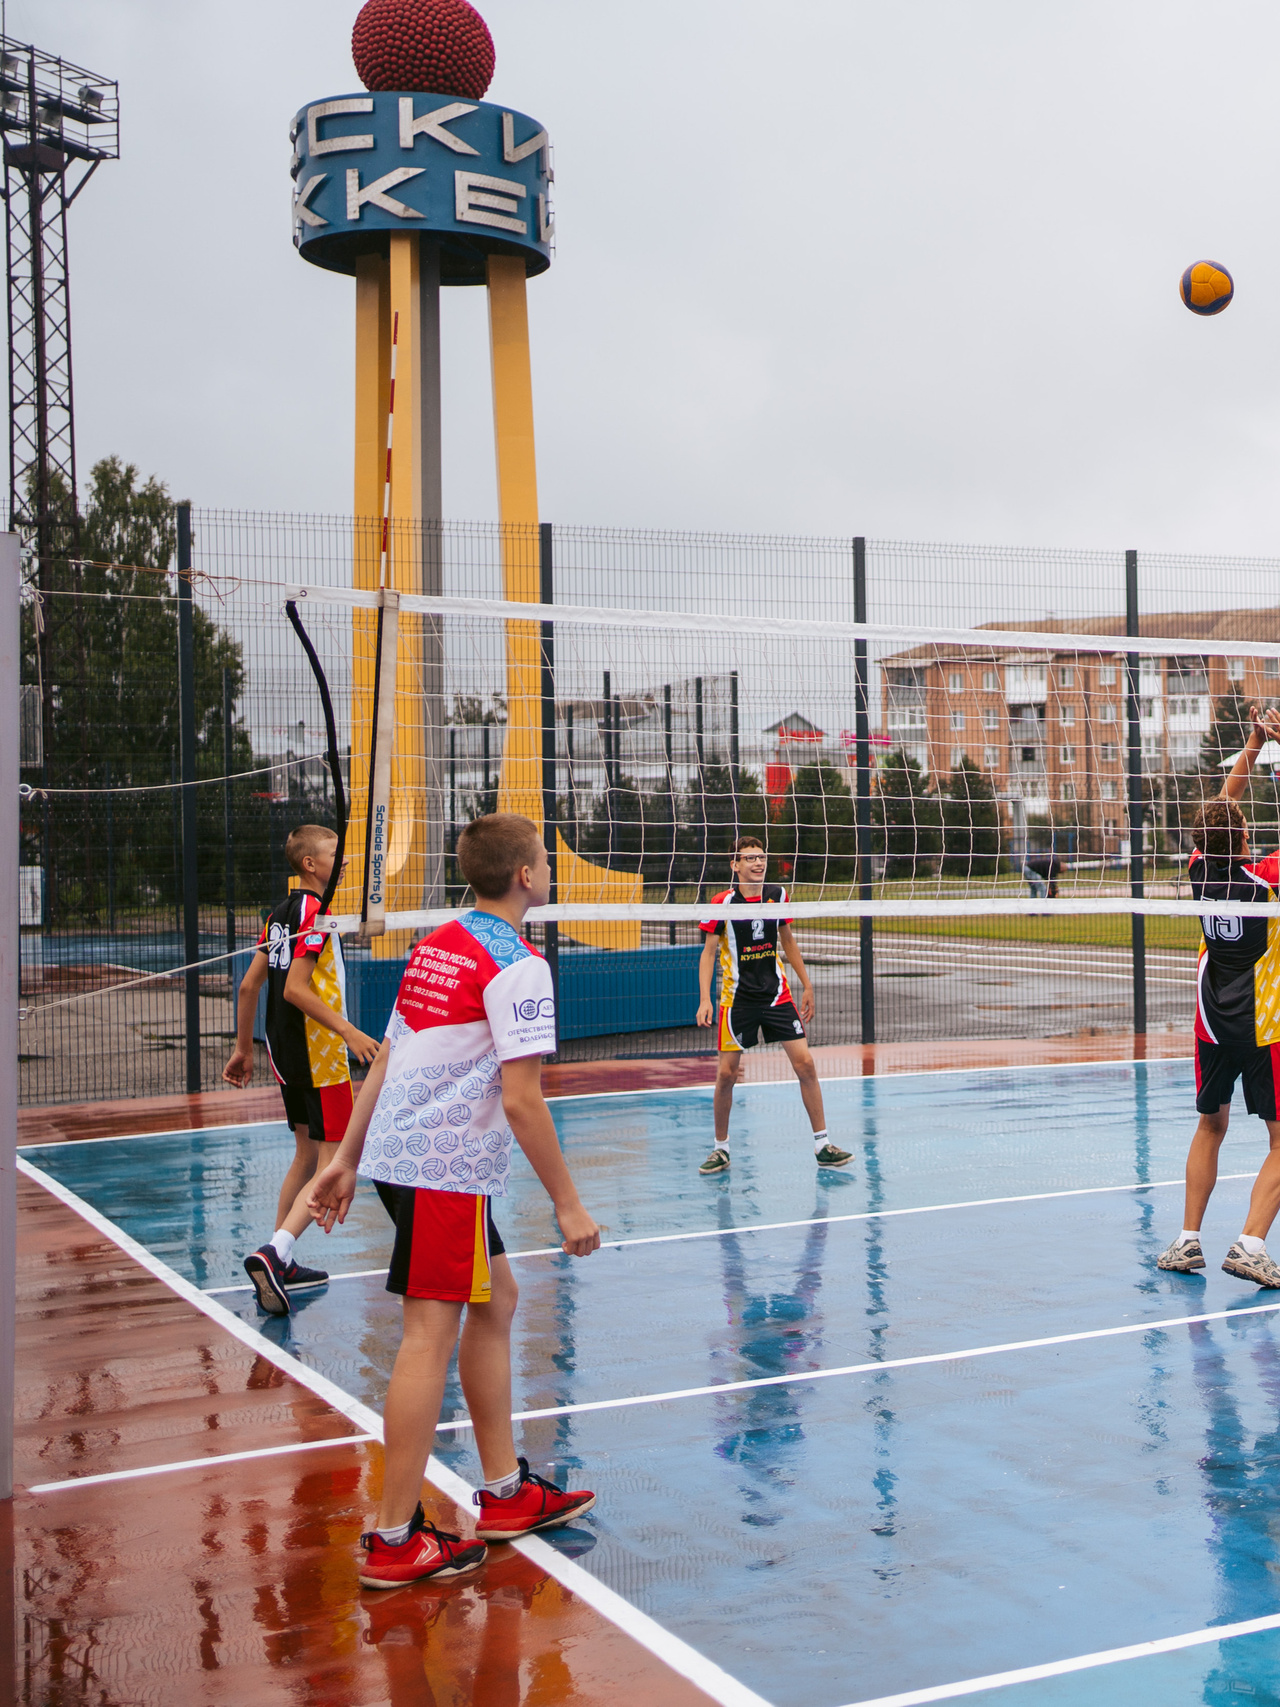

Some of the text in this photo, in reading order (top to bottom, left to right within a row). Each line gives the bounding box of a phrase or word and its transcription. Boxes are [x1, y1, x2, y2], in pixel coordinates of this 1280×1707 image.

[371, 805, 386, 892] Schelde Sports
[751, 919, 764, 940] 2
[512, 997, 556, 1022] 100
